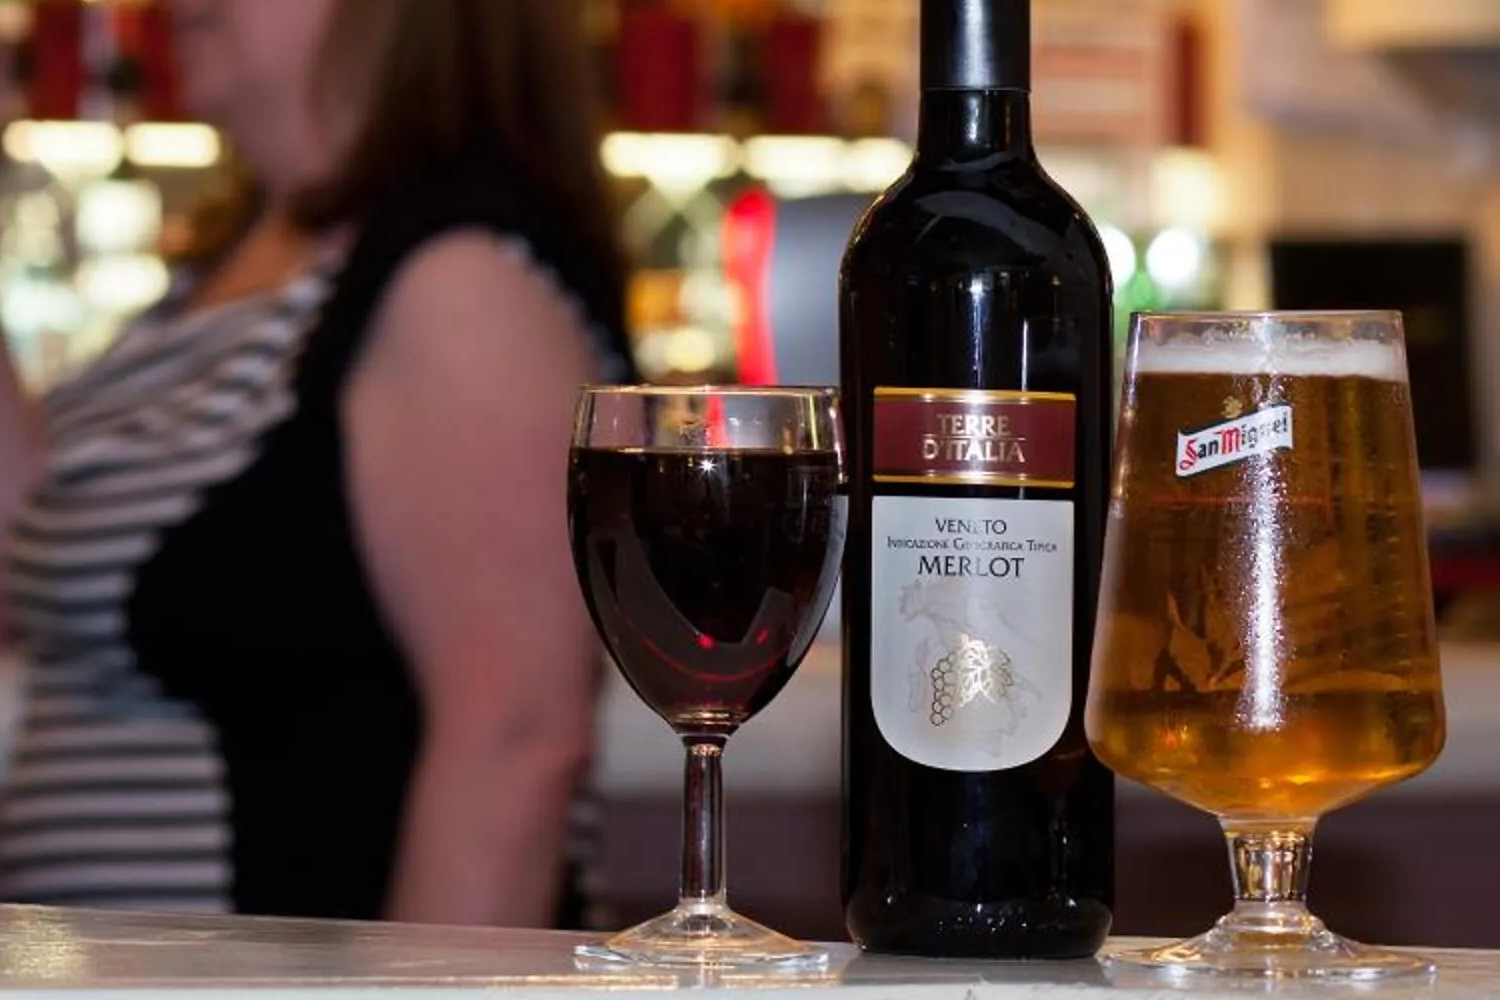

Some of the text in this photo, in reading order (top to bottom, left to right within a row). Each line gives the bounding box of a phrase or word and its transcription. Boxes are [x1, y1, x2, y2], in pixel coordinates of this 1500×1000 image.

[937, 413, 1011, 436] TERRE
[922, 438, 1026, 463] D'ITALIA
[918, 555, 1025, 578] MERLOT
